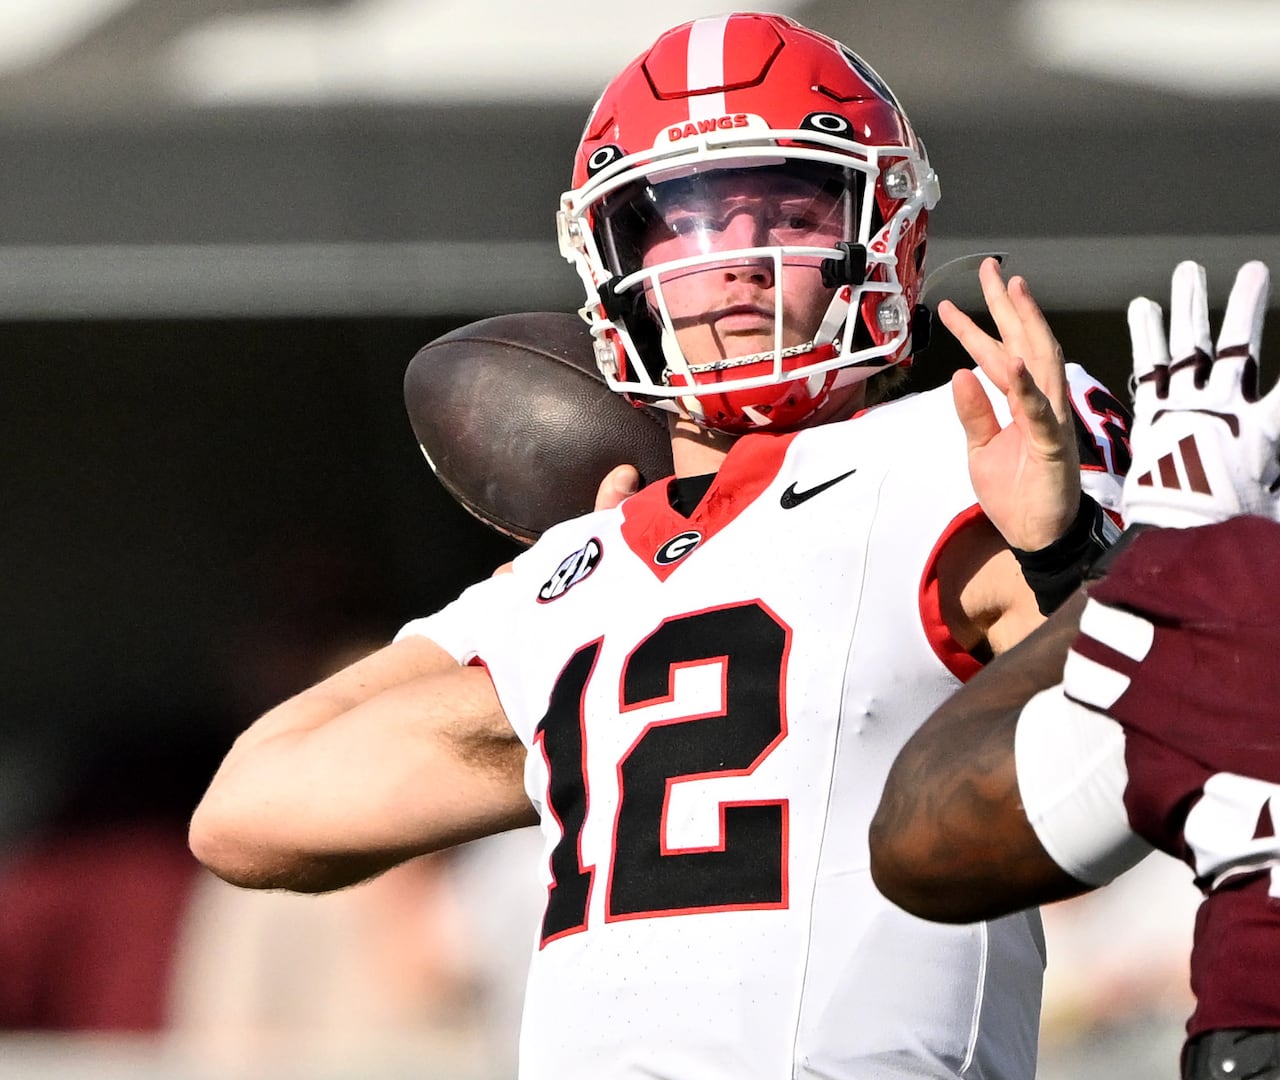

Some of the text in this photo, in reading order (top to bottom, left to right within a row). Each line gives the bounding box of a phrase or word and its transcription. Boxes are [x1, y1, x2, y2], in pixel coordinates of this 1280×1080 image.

[668, 114, 748, 142] DAWGS
[654, 531, 702, 566] G
[533, 597, 793, 950] 12
